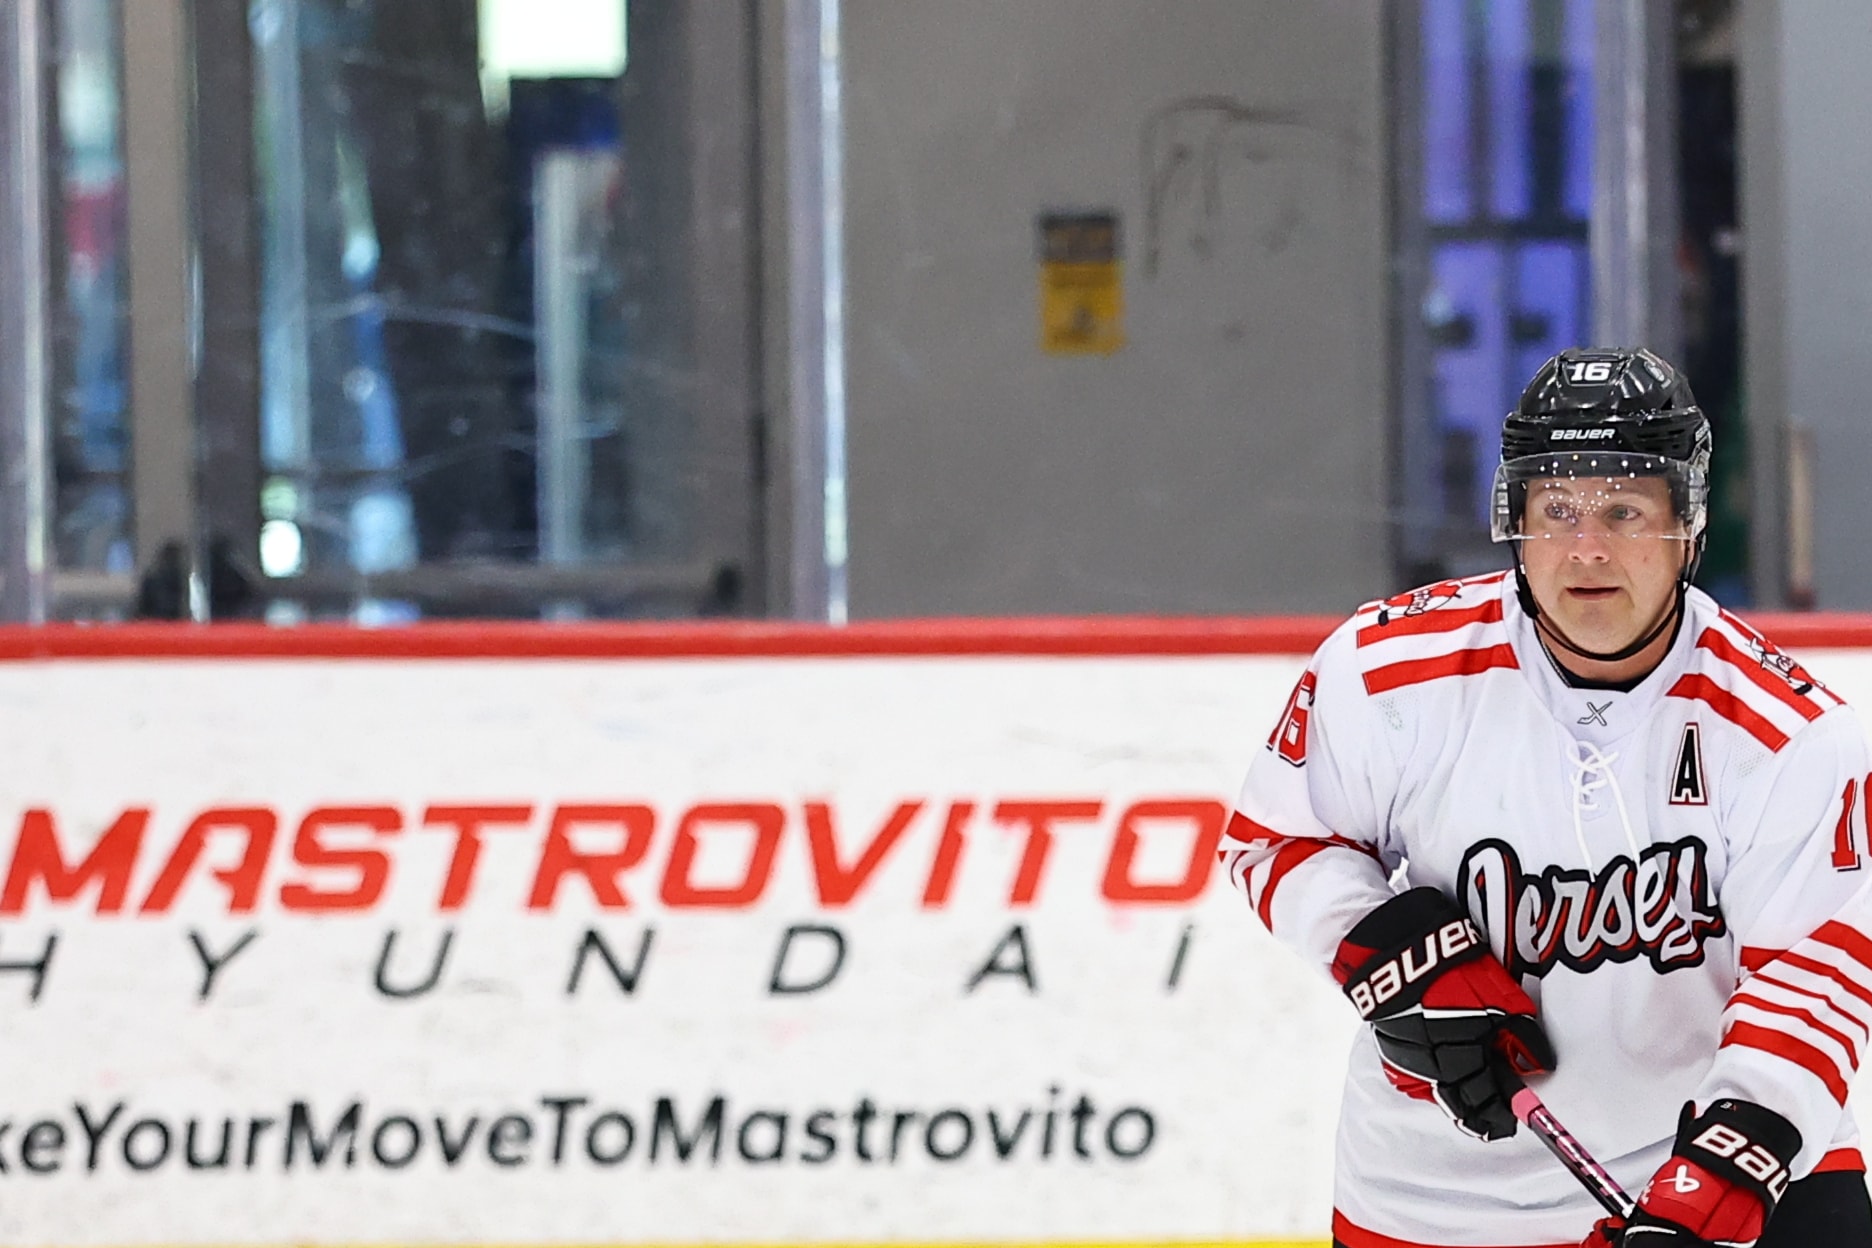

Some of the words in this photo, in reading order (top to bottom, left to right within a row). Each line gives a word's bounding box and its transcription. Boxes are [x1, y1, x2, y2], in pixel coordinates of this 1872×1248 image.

[1568, 361, 1612, 382] 16
[1669, 722, 1708, 806] A
[0, 799, 1227, 915] MASTROVITO
[1457, 835, 1727, 982] Jersey
